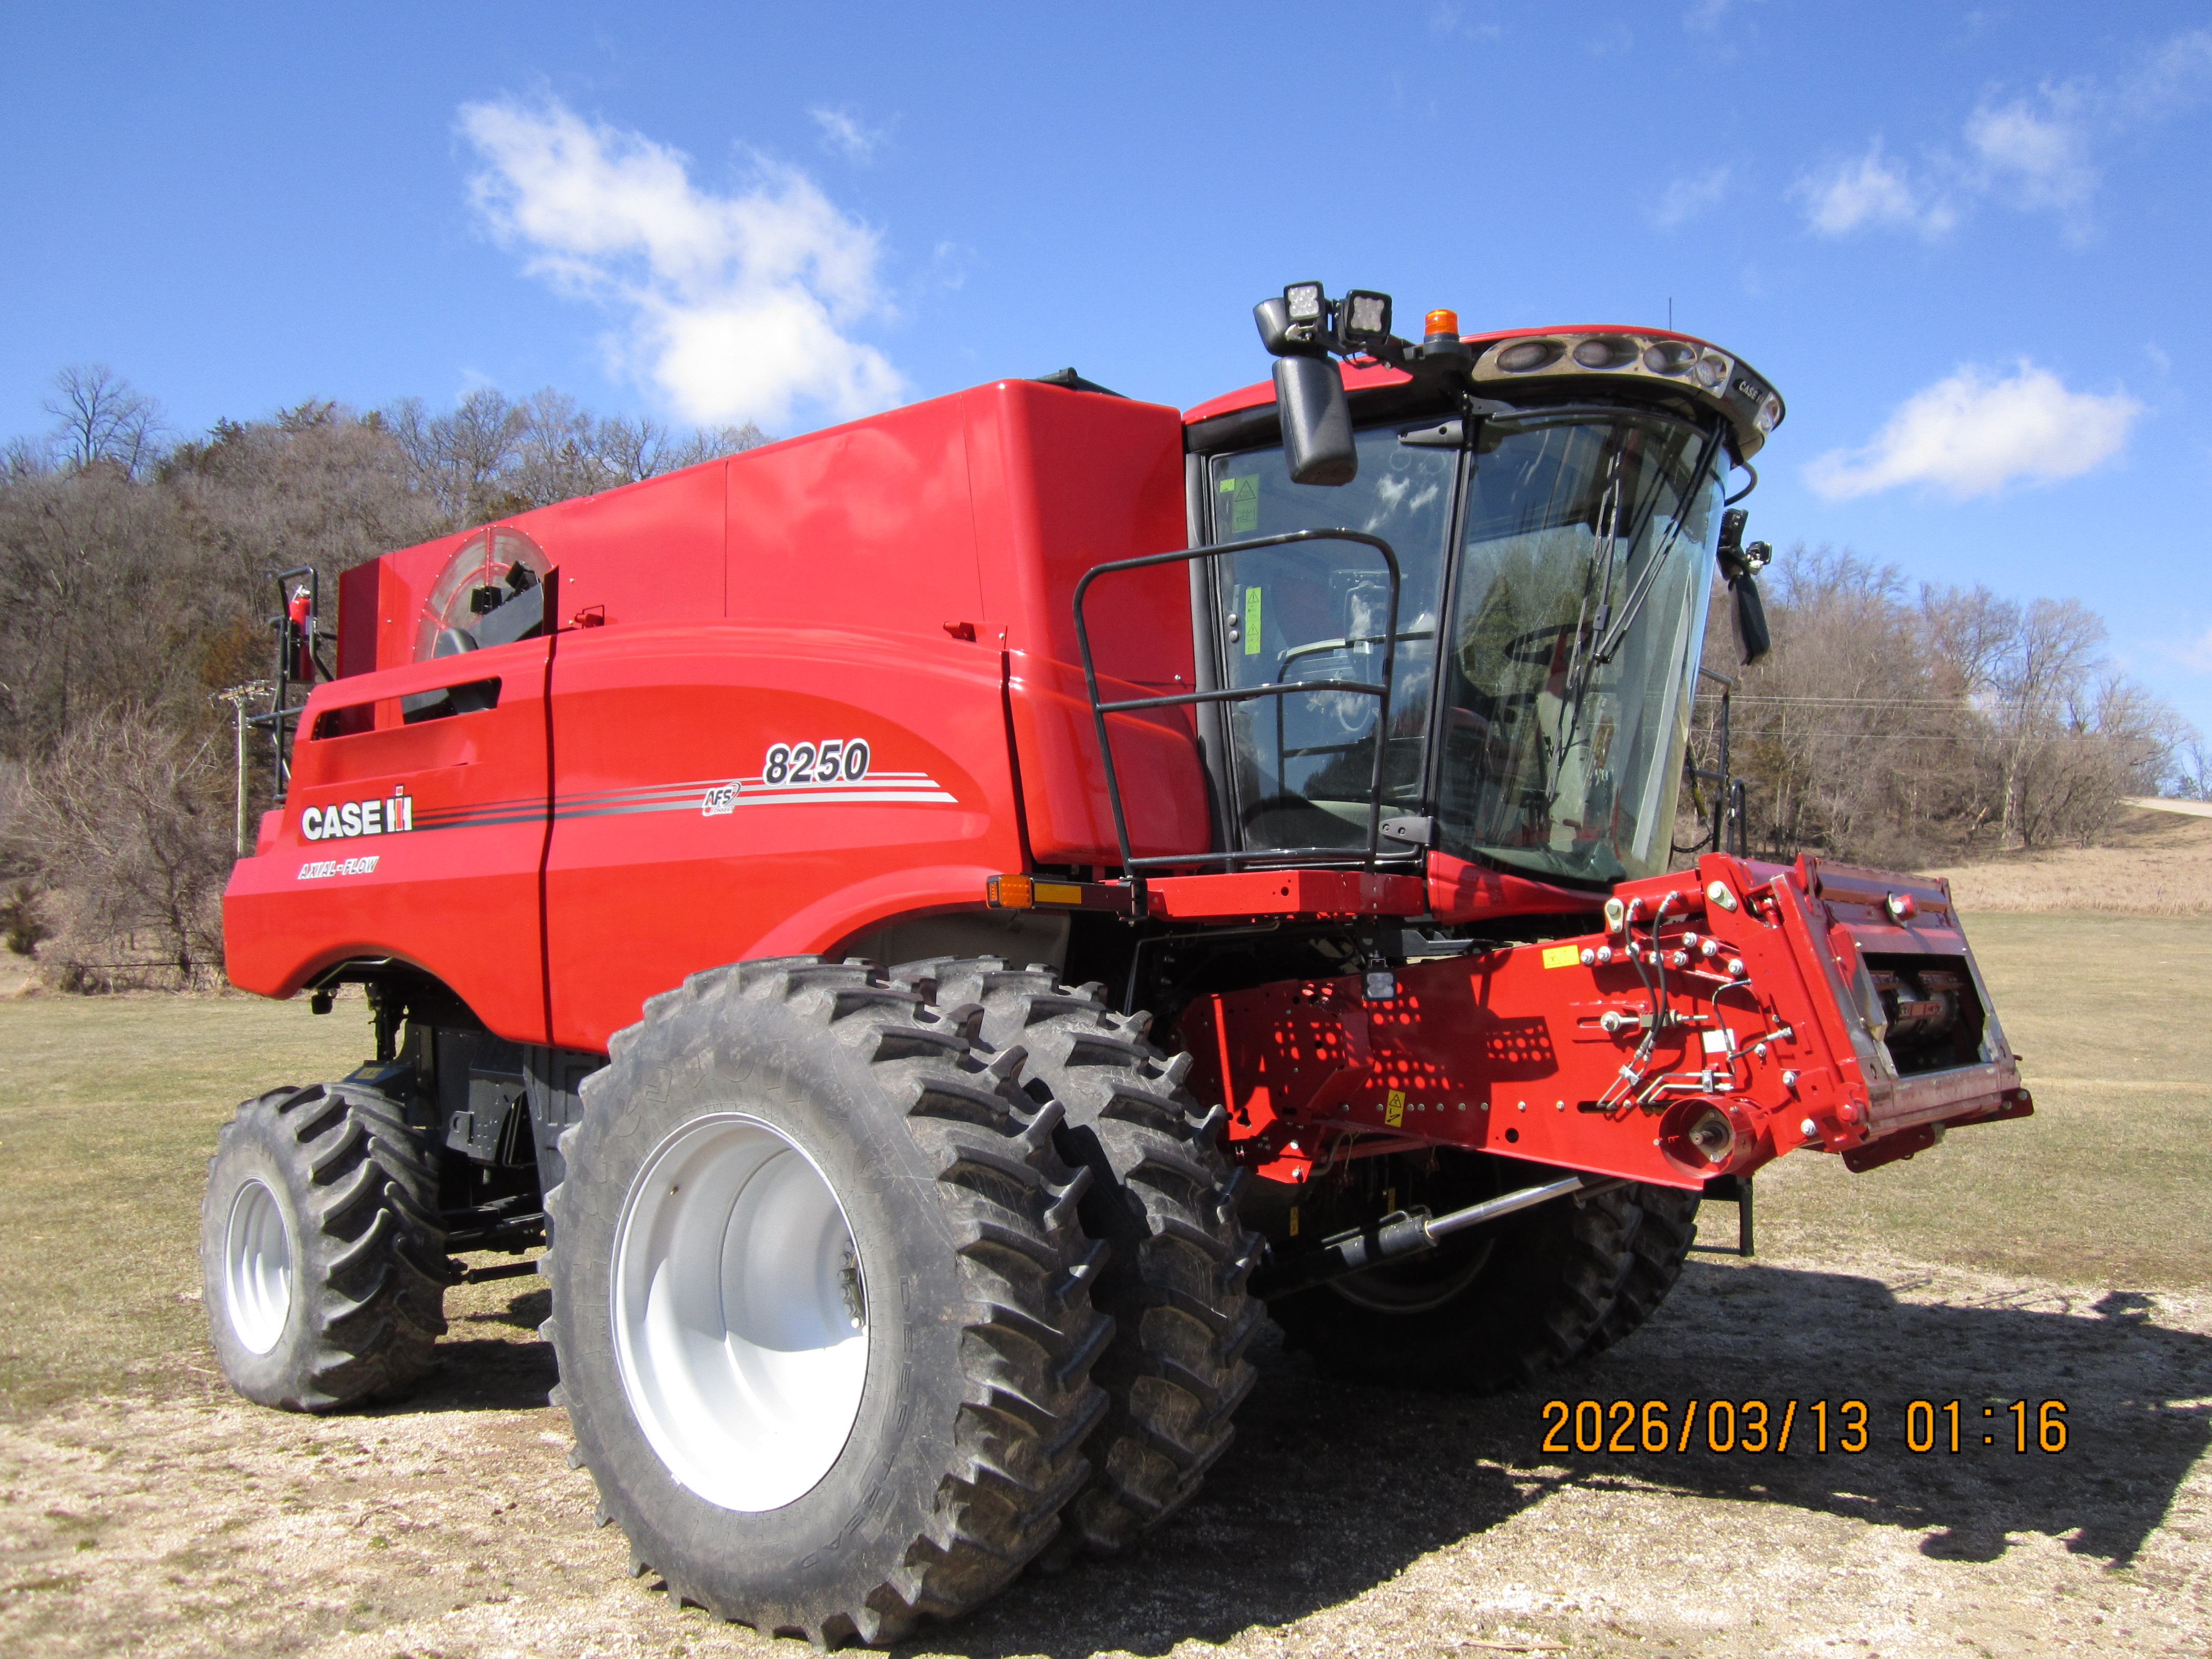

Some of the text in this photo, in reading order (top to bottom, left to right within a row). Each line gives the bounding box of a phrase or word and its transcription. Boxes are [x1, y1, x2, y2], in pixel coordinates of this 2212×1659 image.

[1739, 380, 1758, 400] CASE
[762, 738, 869, 786] 8250
[704, 788, 733, 806] AFS
[302, 800, 382, 841] CASE
[297, 856, 380, 880] AXIAL-FLOW
[799, 1277, 913, 1569] DEEP TREAD
